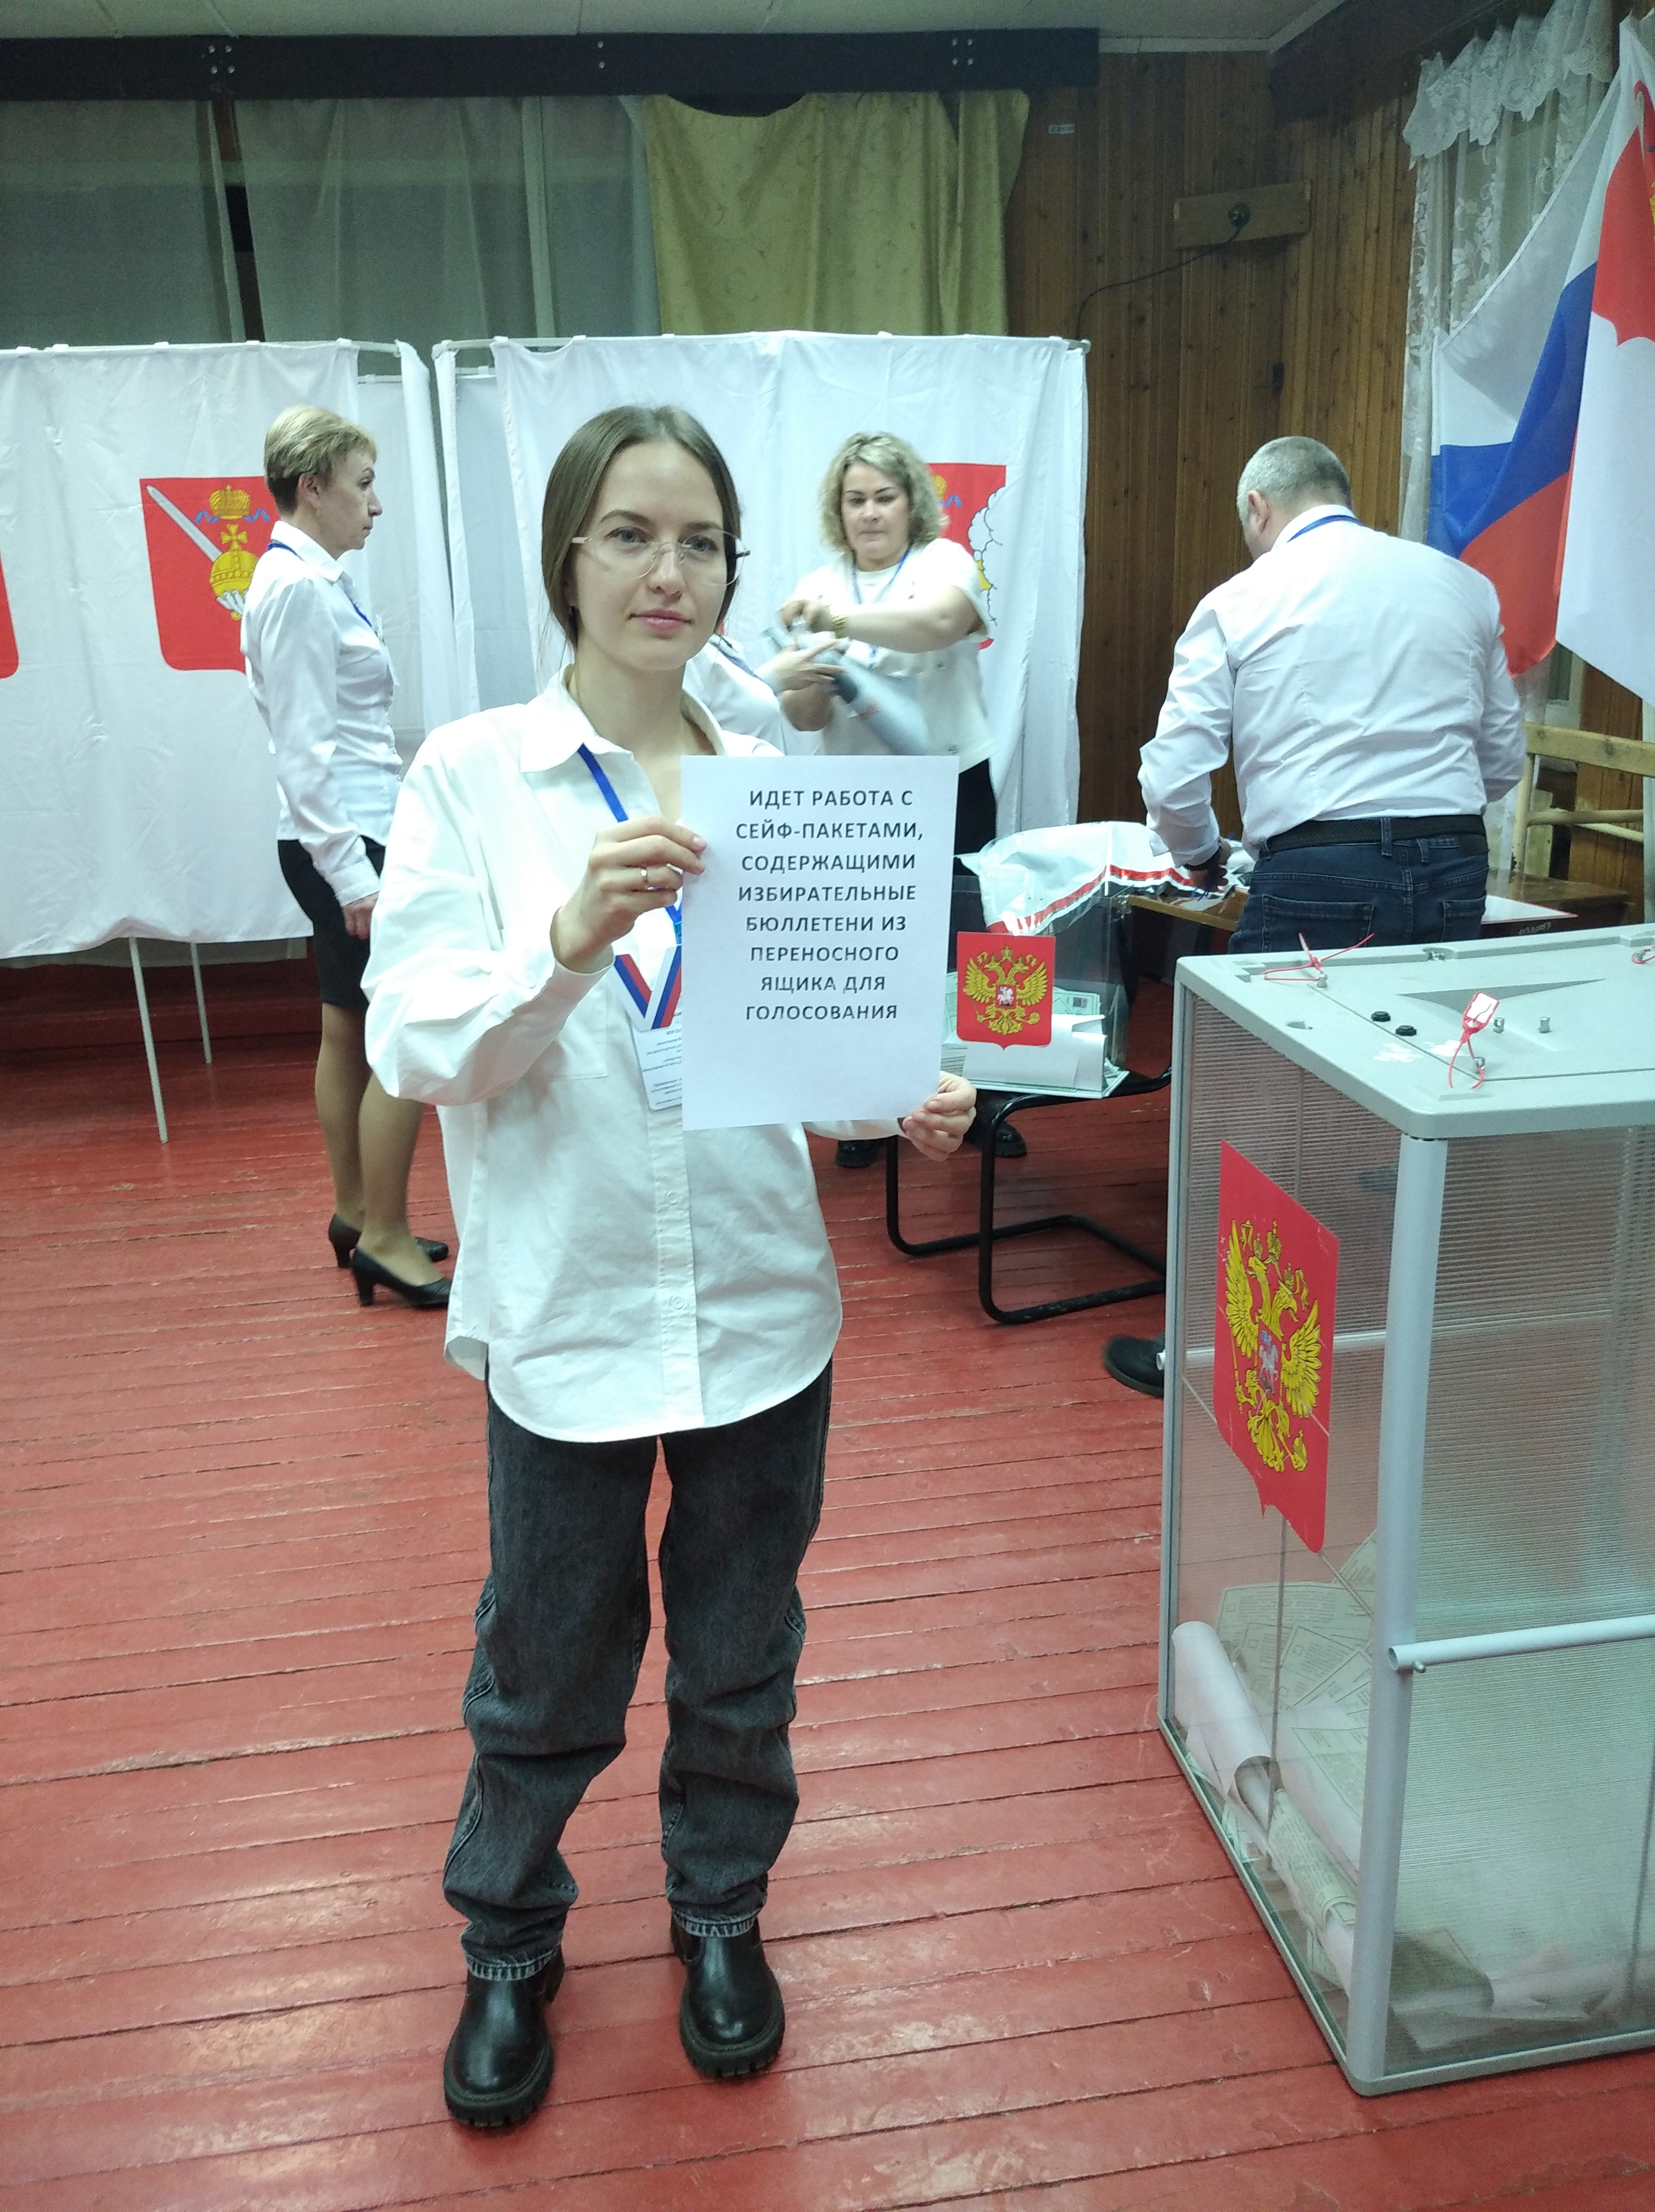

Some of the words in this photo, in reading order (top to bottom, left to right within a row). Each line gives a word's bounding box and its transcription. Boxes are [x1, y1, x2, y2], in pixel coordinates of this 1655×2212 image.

[750, 790, 805, 809] ИДЕТ
[812, 790, 894, 806] РАБОТА
[901, 790, 913, 806] С
[736, 819, 923, 841] СЕЙФ-ПАКЕТАМИ,
[741, 854, 916, 874] СОДЕРЖАЩИМИ
[738, 885, 916, 902] ИЗБИРАТЕЛЬНЫЕ
[746, 916, 874, 932] БЮЛЛЕТЕНИ
[881, 916, 906, 931] ИЗ
[750, 946, 899, 962] ПЕРЕНОСНОГО
[761, 976, 837, 995] ЯЩИКА
[842, 976, 886, 994] ДЛЯ
[746, 1005, 898, 1020] ГОЛОСОВАНИЯ
